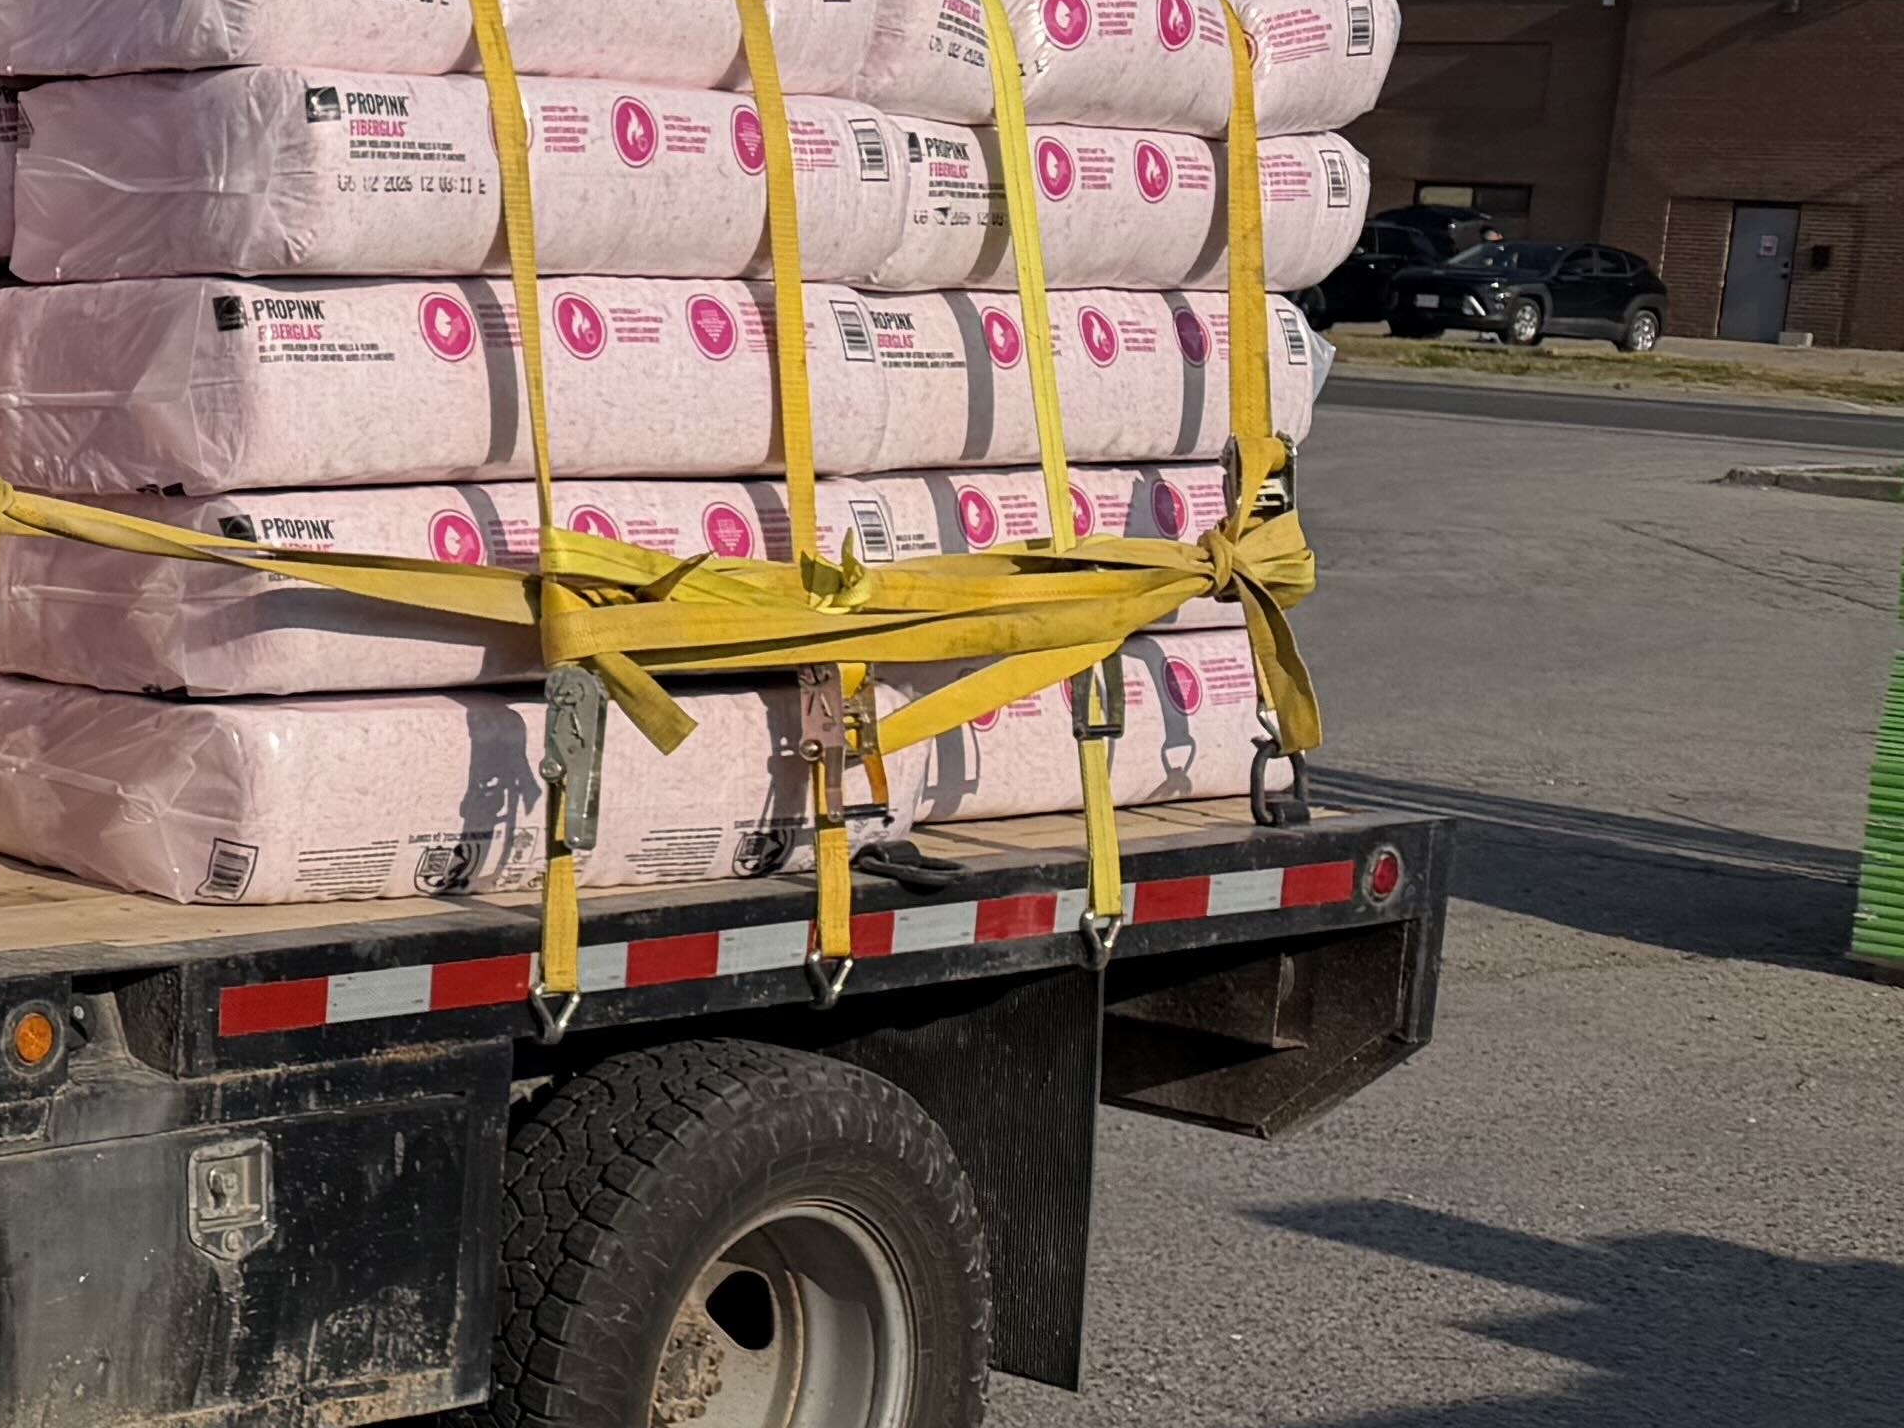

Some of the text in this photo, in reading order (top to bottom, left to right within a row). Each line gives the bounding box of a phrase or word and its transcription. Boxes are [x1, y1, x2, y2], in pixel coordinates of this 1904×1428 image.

[346, 92, 409, 117] PROPINK
[349, 119, 406, 138] FIBERGLAS
[252, 298, 325, 321] PROPINK
[258, 324, 322, 342] FBERGLAS
[261, 517, 335, 541] PROPINK
